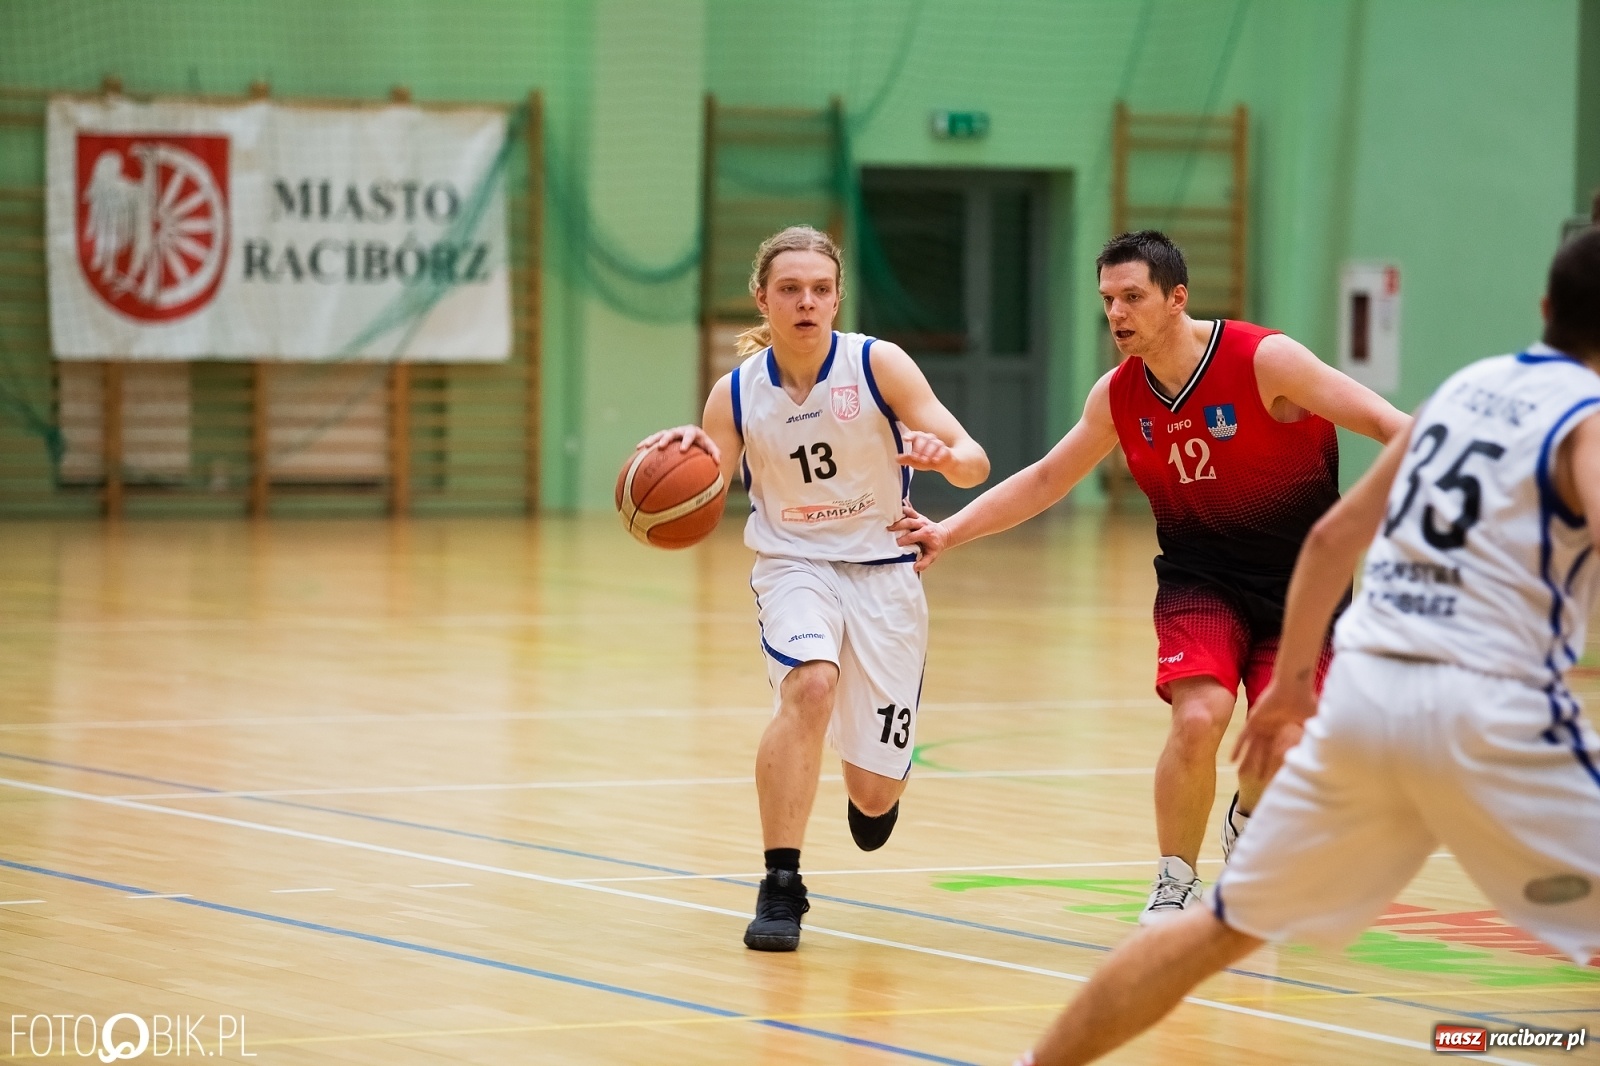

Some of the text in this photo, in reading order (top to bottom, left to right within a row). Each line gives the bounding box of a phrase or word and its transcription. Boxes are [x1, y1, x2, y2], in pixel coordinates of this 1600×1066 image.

[273, 178, 460, 223] MIASTO
[242, 233, 490, 284] RACIBÓRZ
[789, 442, 837, 483] 13
[1168, 438, 1217, 484] 12
[1384, 424, 1506, 551] 35
[806, 502, 866, 520] KAMPKA
[877, 703, 911, 749] 13
